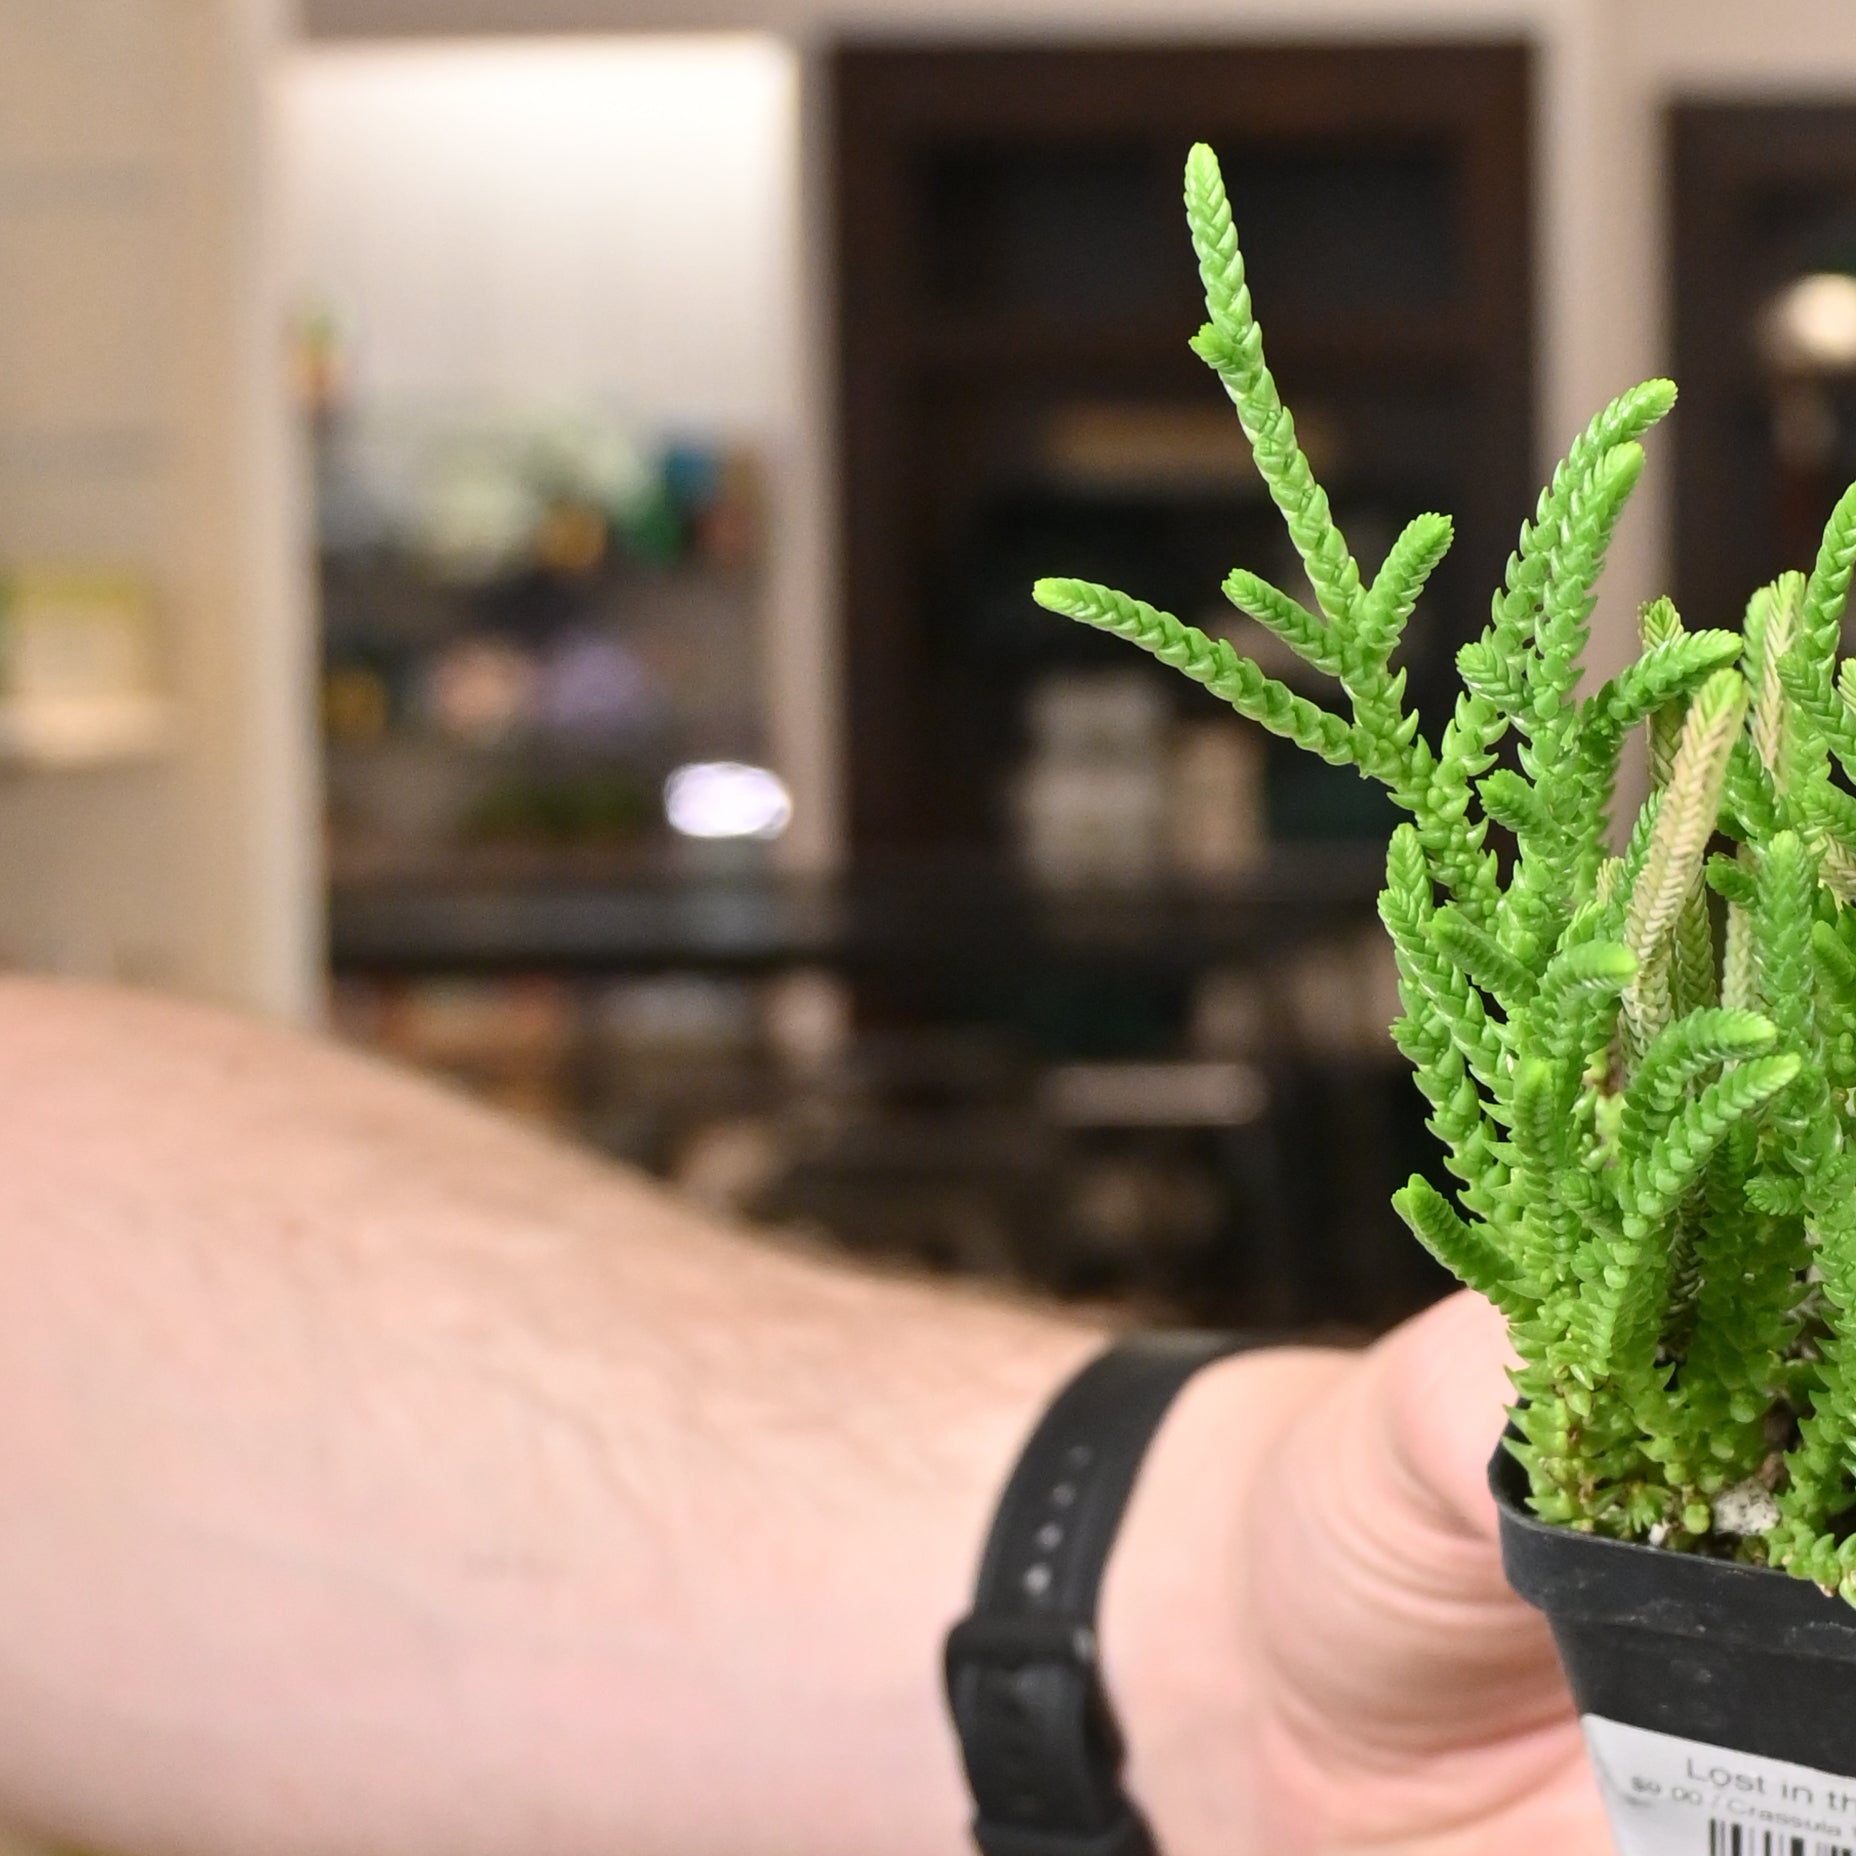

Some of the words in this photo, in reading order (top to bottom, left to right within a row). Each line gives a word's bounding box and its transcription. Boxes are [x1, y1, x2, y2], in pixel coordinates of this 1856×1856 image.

[1686, 1756, 1766, 1794] Lost
[1781, 1782, 1814, 1805] in
[1726, 1798, 1842, 1837] Crassula
